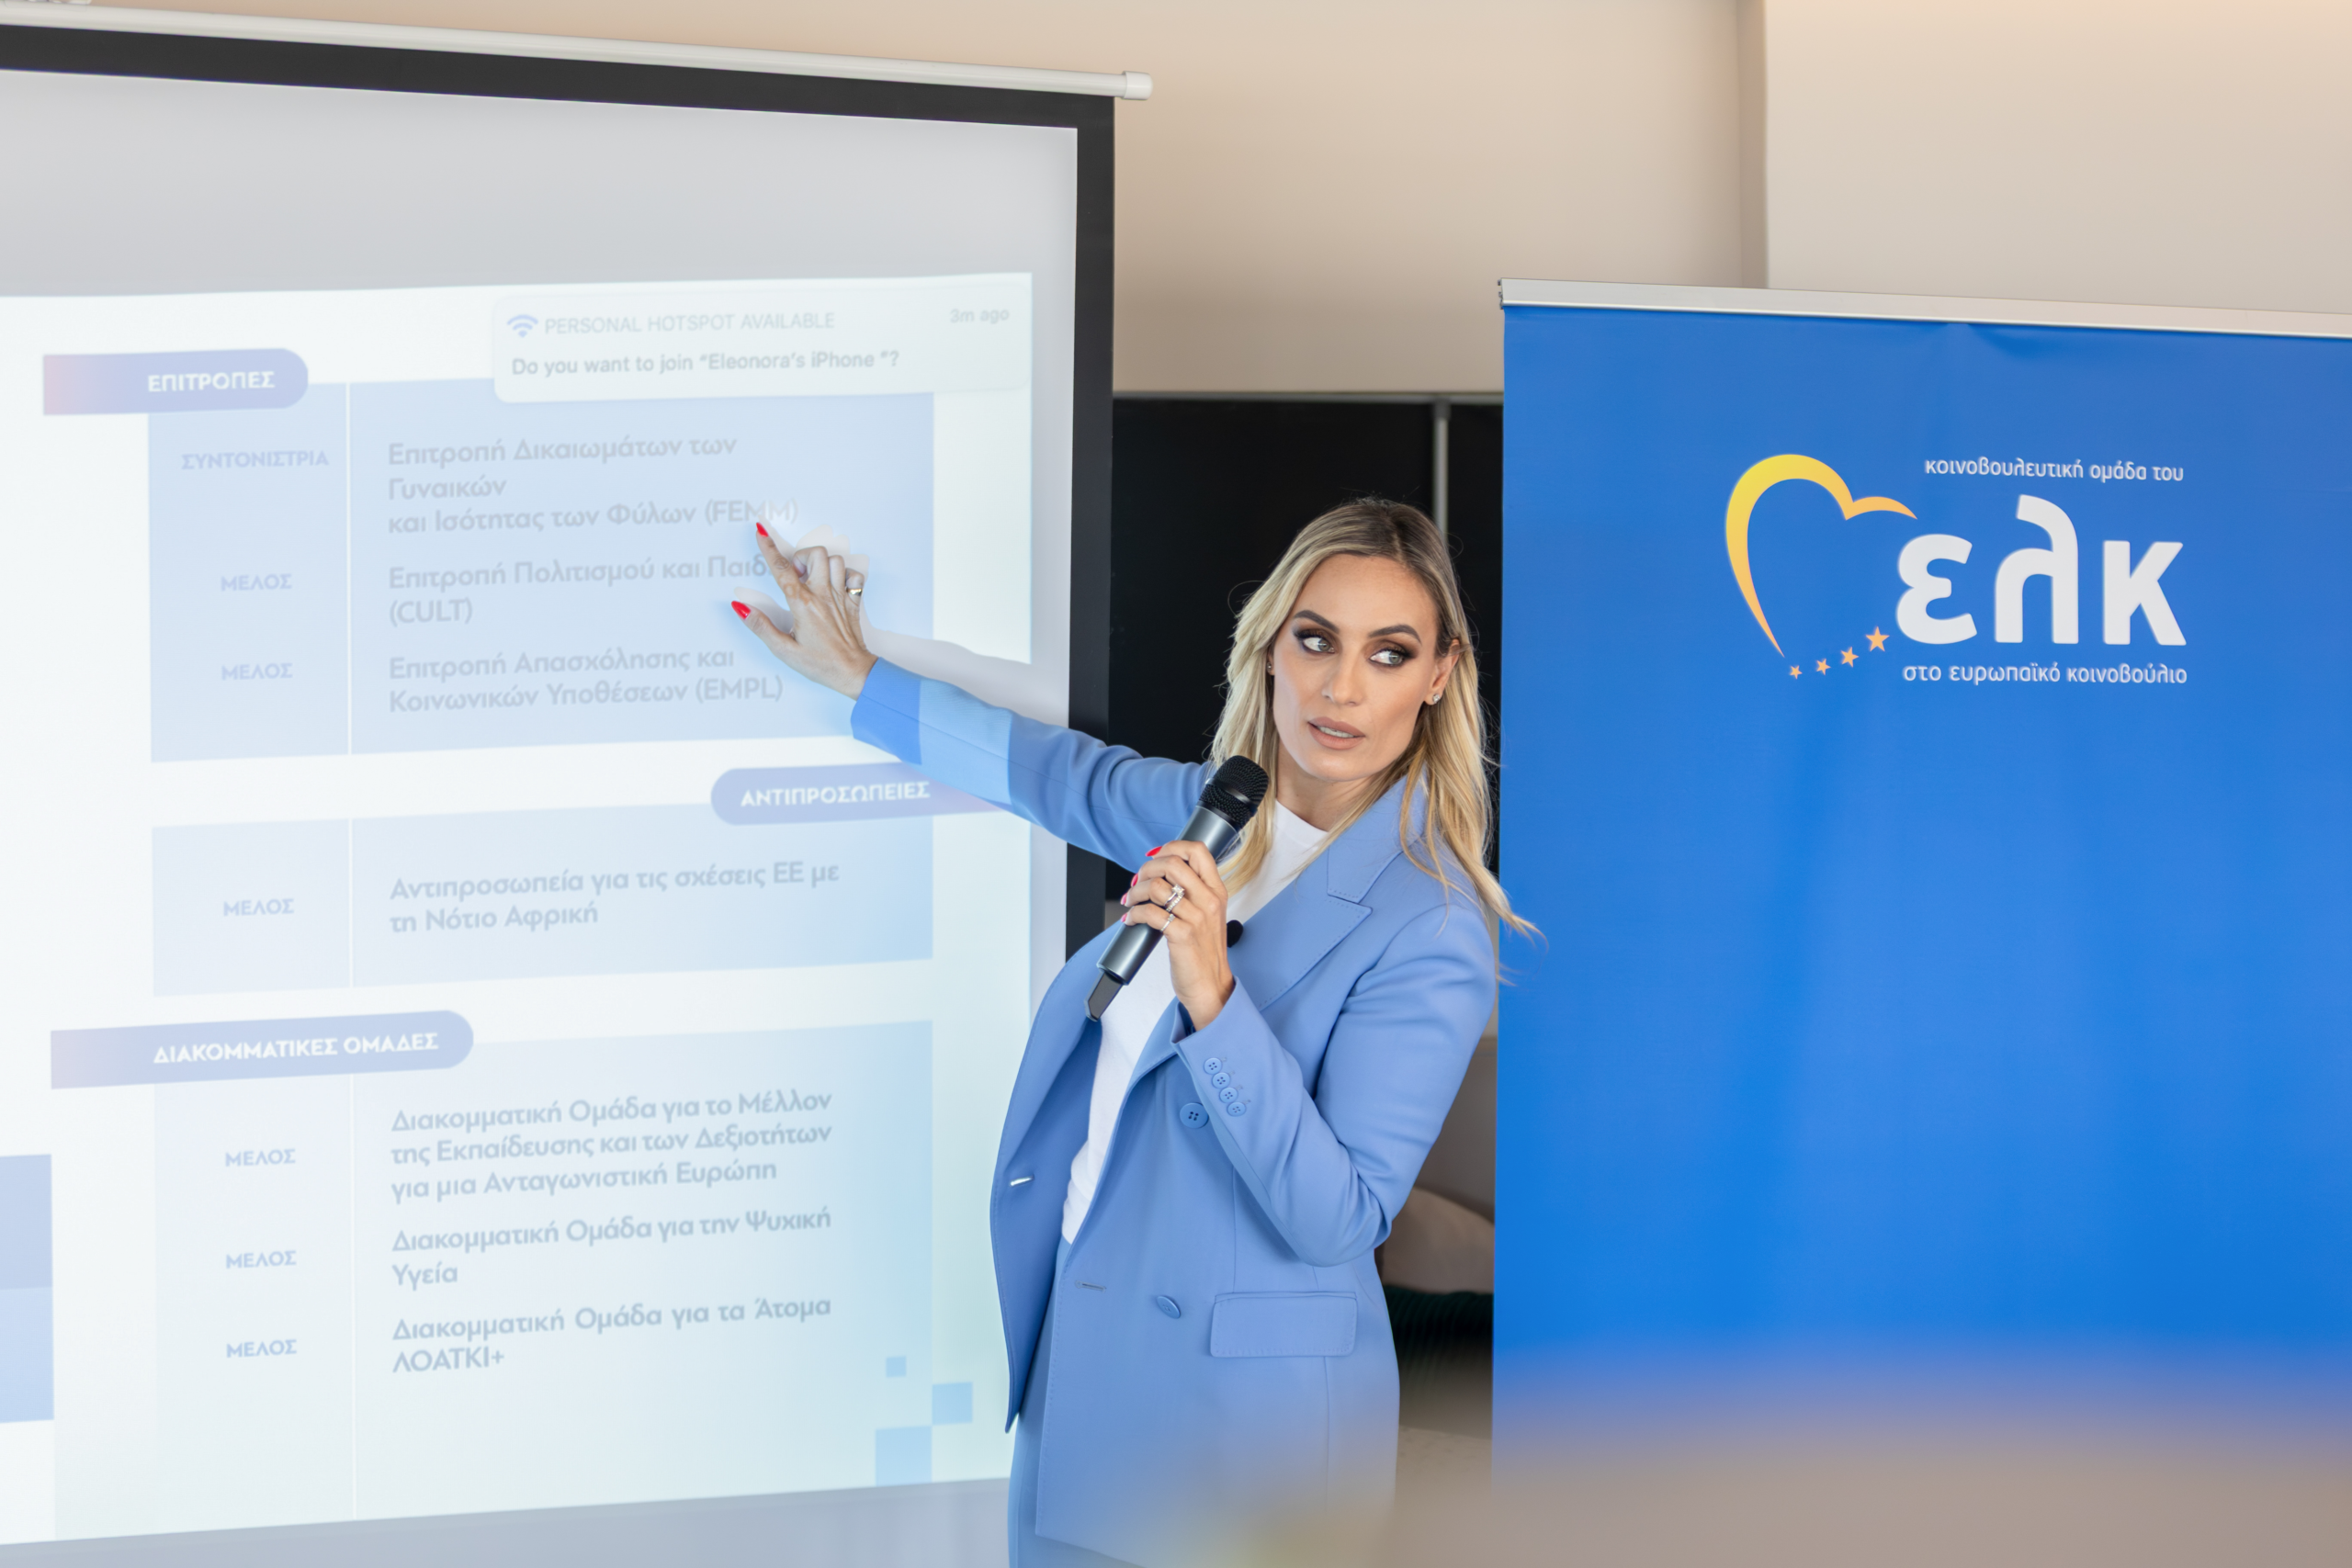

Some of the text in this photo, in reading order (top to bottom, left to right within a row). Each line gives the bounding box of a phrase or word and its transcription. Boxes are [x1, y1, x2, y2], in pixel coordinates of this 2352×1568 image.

[544, 312, 835, 334] PERSONAL HOTSPOT AVAILABLE
[949, 308, 1010, 324] 3m ago
[512, 357, 539, 375] Do
[544, 360, 579, 378] you
[583, 356, 631, 373] want
[635, 355, 655, 372] to
[660, 353, 694, 374] join
[810, 350, 875, 368] iPhone
[147, 370, 276, 392] ΕΠΙΤΡΟΠΕΣ
[180, 450, 330, 470] ΣΥΝΤΟΝΙΣΤΡΙΑ
[388, 434, 738, 470] Επιτροπή Δικαιωμάτων των
[1925, 457, 2185, 483] κοινοβουλευτική ομάδα του
[388, 473, 507, 501] Γυναικών
[388, 498, 799, 534] και Ισότητας των Φύλων (FEMM)
[220, 574, 293, 592] ΜΕΛΟΣ
[389, 553, 773, 593] Επιτροπή Πολιτισμού και Παιδ
[1895, 493, 2188, 647] ελκ
[389, 597, 473, 627] (CULT)
[220, 663, 294, 681] ΜΕΛΟΣ
[389, 646, 735, 683] Επιτροπή Απασχόλησης και
[1903, 661, 2188, 685] στο ευρωπαϊκό κοινοβούλιο
[390, 675, 784, 713] Κοινωνικών Υποθέσεων (EMPL)
[740, 781, 931, 807] ΑΝΤΙΠΡΟΣΩΠΕΙΕΣ
[390, 861, 840, 902] Αντιπροσωπεία για τις σχέσεις ΕΕ με
[222, 898, 295, 917] ΜΕΛΟΣ
[390, 900, 599, 933] τη Νότιο Αφρική
[153, 1032, 438, 1064] ΔΙΑΚΟΜΜΑΤΙΚΕΣ ΟΜΑΔΕΣ
[390, 1088, 832, 1134] Διακομματική Ομάδα για το Μέλλον
[224, 1148, 297, 1168] ΜΕΛΟΣ
[390, 1122, 832, 1168] της Εκπαίδευσης και των Δεξιοτήτων
[390, 1157, 778, 1206] για μια Ανταγωνιστική Ευρώπη
[391, 1205, 832, 1254] Διακομματική Ομάδα για την Ψυχική
[225, 1250, 298, 1269] ΜΕΛΟΣ
[391, 1261, 459, 1292] Υγεία
[391, 1297, 832, 1342] Διακομματική Ομάδα για τα Άτομα
[226, 1339, 298, 1359] ΜΕΛΟΣ
[392, 1346, 505, 1374] ΛΟΑΤΚΙ+
